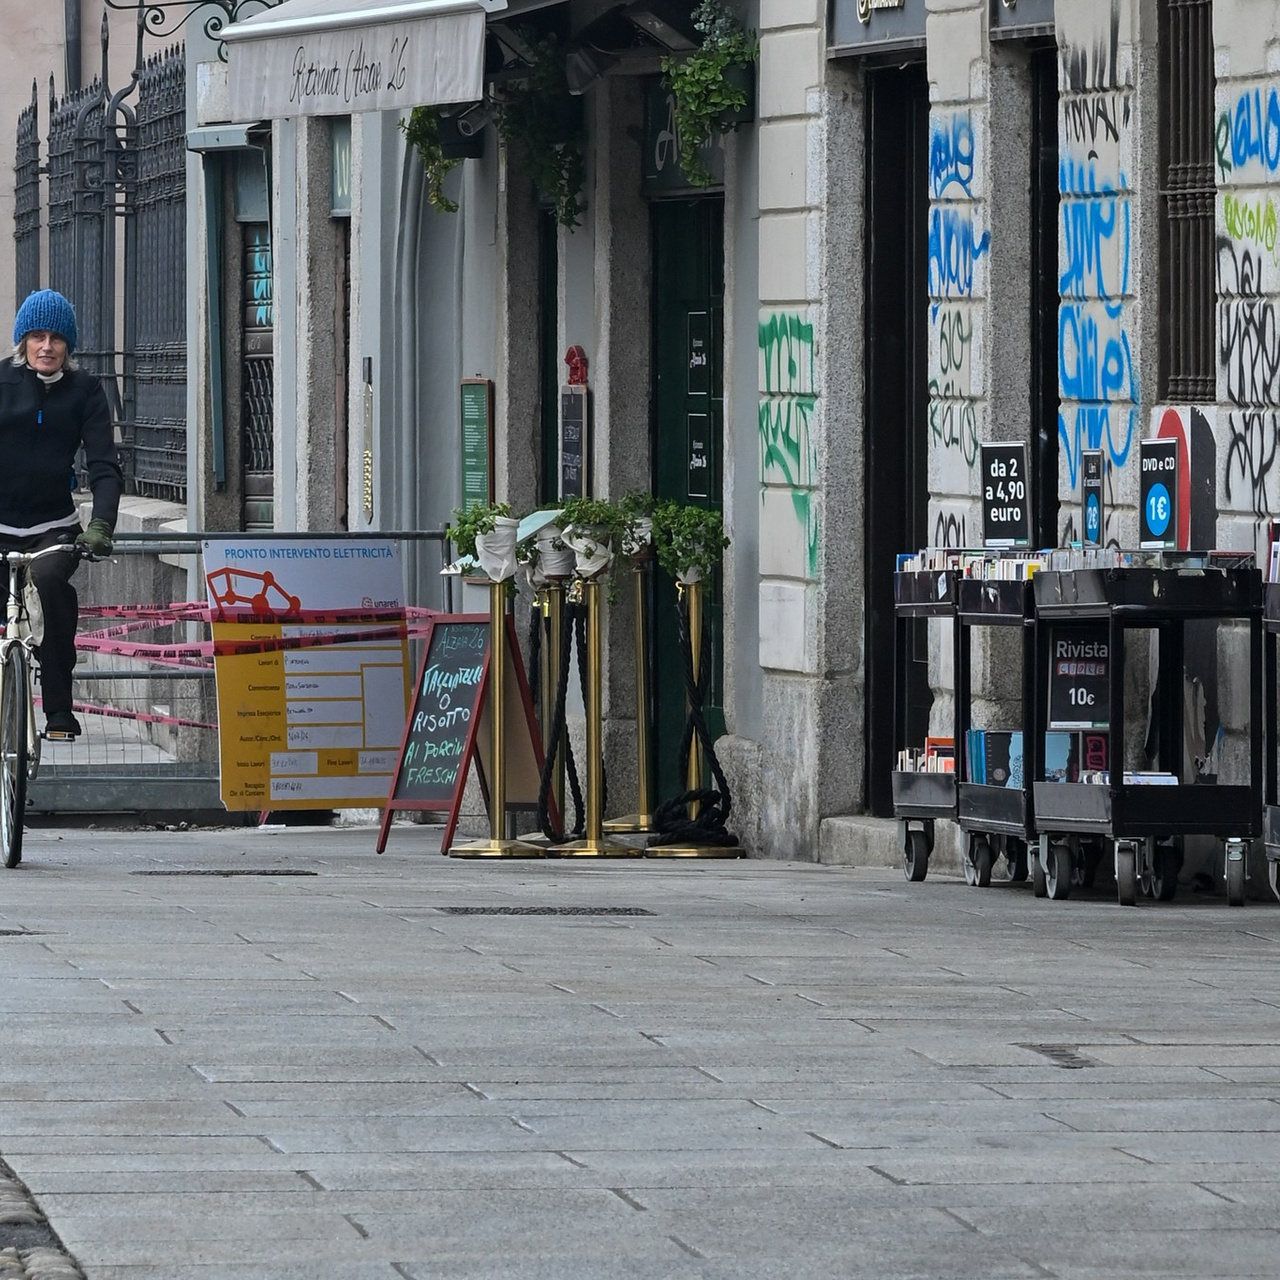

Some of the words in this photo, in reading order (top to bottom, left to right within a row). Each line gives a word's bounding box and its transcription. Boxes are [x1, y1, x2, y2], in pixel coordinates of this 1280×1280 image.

[387, 37, 409, 91] 26
[991, 458, 1007, 477] da
[1010, 458, 1018, 477] 2
[1142, 458, 1157, 471] DVD
[1158, 460, 1164, 470] e
[1164, 456, 1175, 470] CD
[986, 485, 994, 500] a
[996, 481, 1025, 503] 4,90
[991, 507, 1022, 522] euro
[1088, 506, 1098, 530] 2€
[1150, 496, 1167, 520] 1€
[224, 548, 267, 559] PRONTO
[270, 547, 331, 559] INTERVENTO
[333, 545, 394, 559] ELETTRICITÀ
[374, 598, 399, 608] unareti
[468, 627, 485, 649] 26
[1056, 640, 1108, 658] Rivista
[439, 693, 451, 710] O
[1069, 687, 1095, 706] 10€
[413, 707, 471, 733] RISOTTO
[404, 741, 420, 768] AI
[405, 762, 460, 789] FRESCHI
